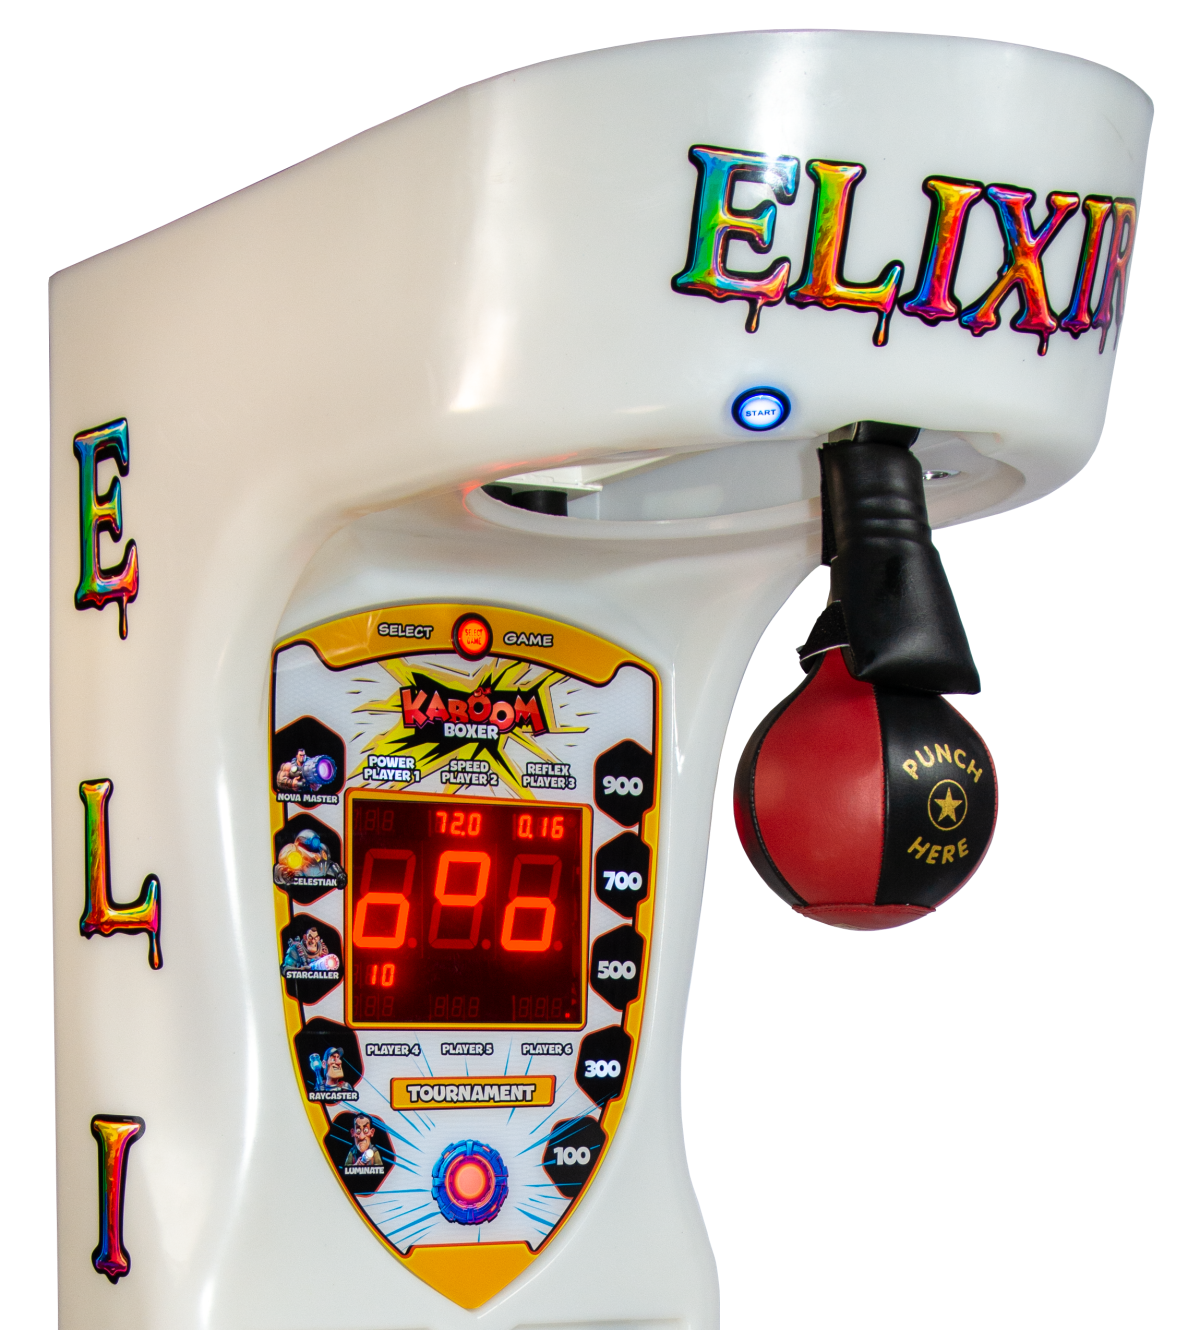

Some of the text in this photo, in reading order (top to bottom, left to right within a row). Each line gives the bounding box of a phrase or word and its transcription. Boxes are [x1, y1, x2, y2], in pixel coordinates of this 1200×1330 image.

[671, 144, 1137, 355] ELIXIR
[745, 408, 777, 417] START
[377, 623, 554, 648] SELECT GAME
[464, 628, 484, 637] SELECT
[400, 687, 547, 737] KABOOM
[444, 723, 499, 740] BOXER
[368, 755, 416, 770] POWER
[449, 760, 489, 773] SPEED
[527, 763, 571, 776] REFLEX
[902, 743, 983, 783] PUNCH
[363, 768, 421, 783] PLAYER 1
[441, 771, 499, 786] PLAYER 2
[522, 775, 577, 789] PLAYER 3
[602, 776, 643, 795] 900
[277, 793, 338, 803] NOVA MASTER
[436, 811, 482, 836] 72.0
[518, 814, 565, 839] 0.16
[907, 836, 970, 864] HERE
[602, 871, 643, 890] 700
[286, 970, 340, 980] STARCALLER
[370, 963, 396, 987] 10
[597, 960, 636, 980] 500
[366, 1044, 420, 1056] PLAYER 4
[442, 1044, 494, 1055] PLAYER 5
[522, 1044, 573, 1055] PLAYER 6
[584, 1060, 621, 1078] 300
[308, 1092, 358, 1101] RAYCASTER
[407, 1085, 535, 1103] TOURNAMENT
[553, 1147, 591, 1165] 100
[344, 1166, 385, 1175] LUMINATE
